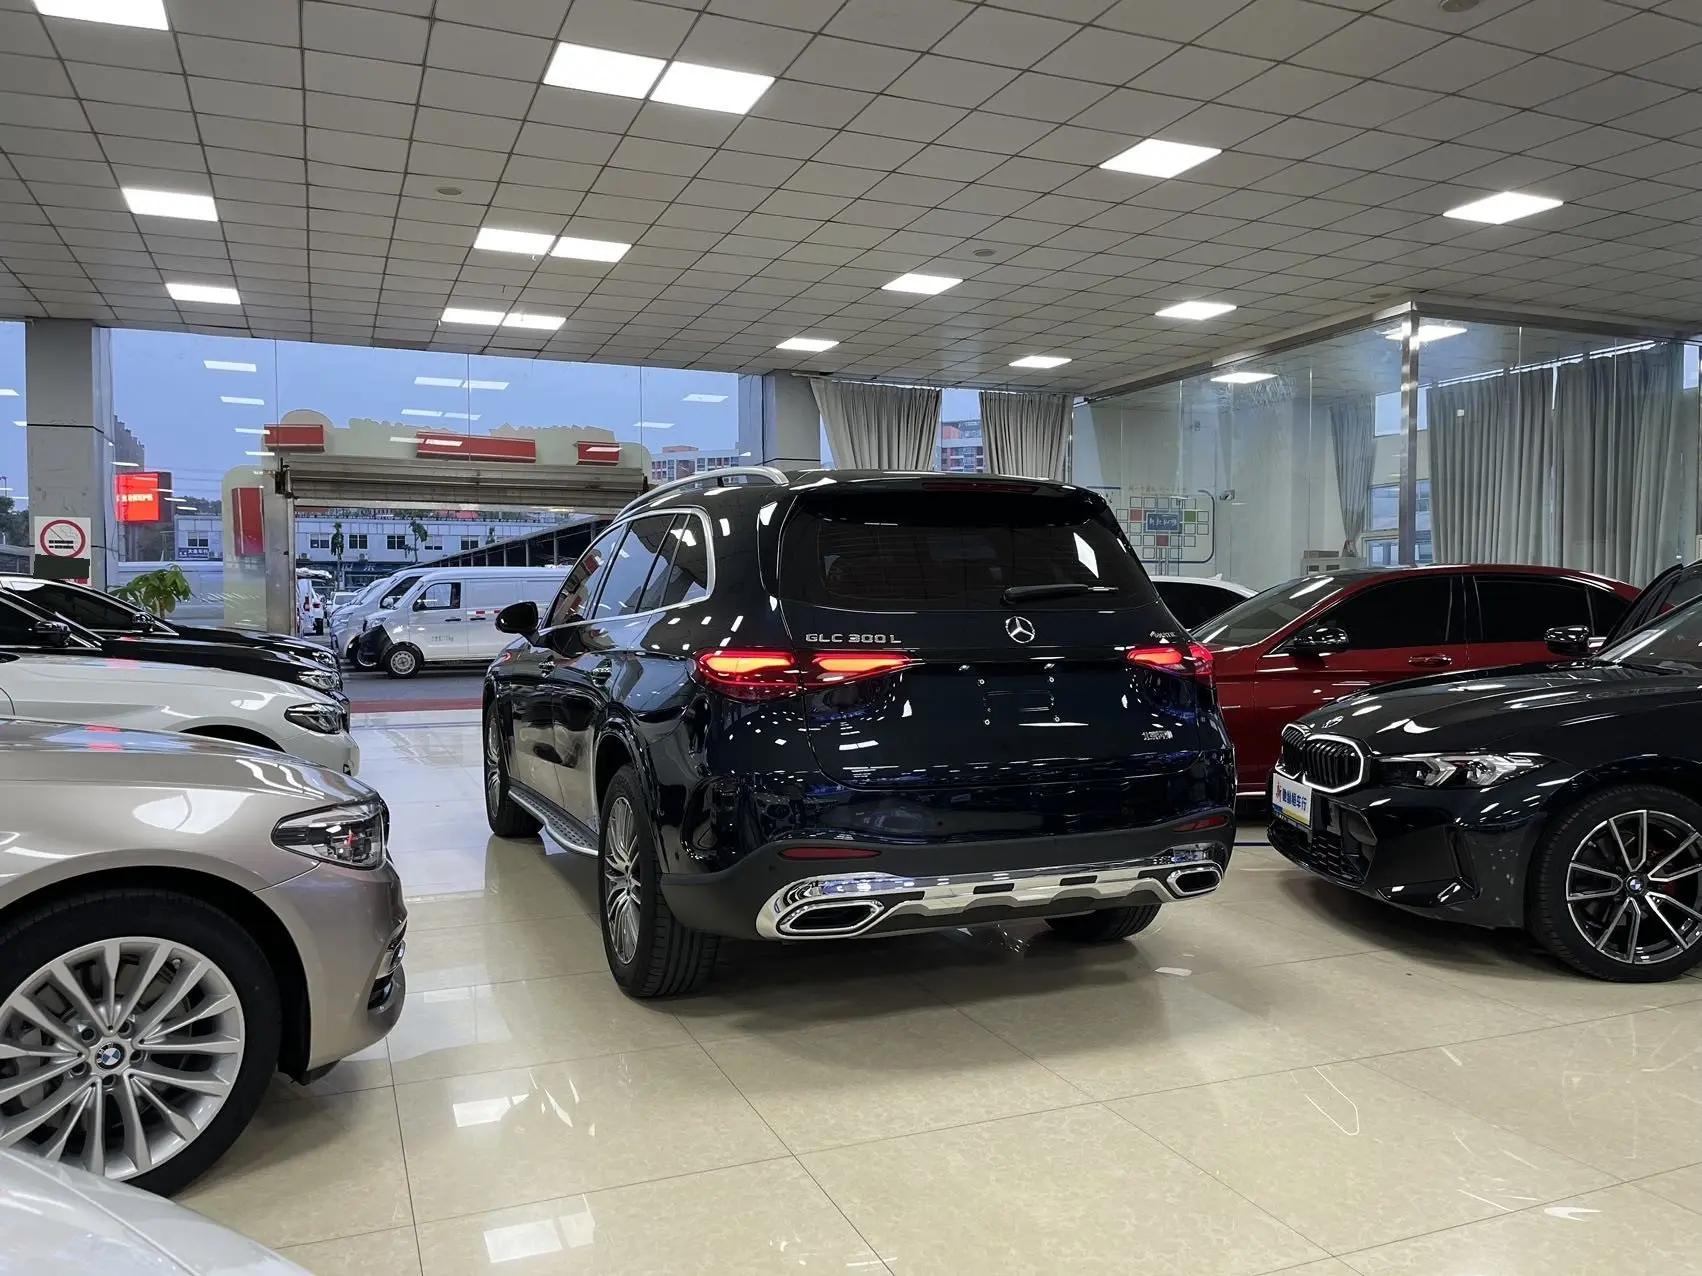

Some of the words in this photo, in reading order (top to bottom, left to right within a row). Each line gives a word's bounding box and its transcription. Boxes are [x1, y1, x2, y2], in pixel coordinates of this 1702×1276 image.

[805, 633, 843, 643] GLC
[848, 634, 886, 644] 300
[890, 634, 902, 644] L
